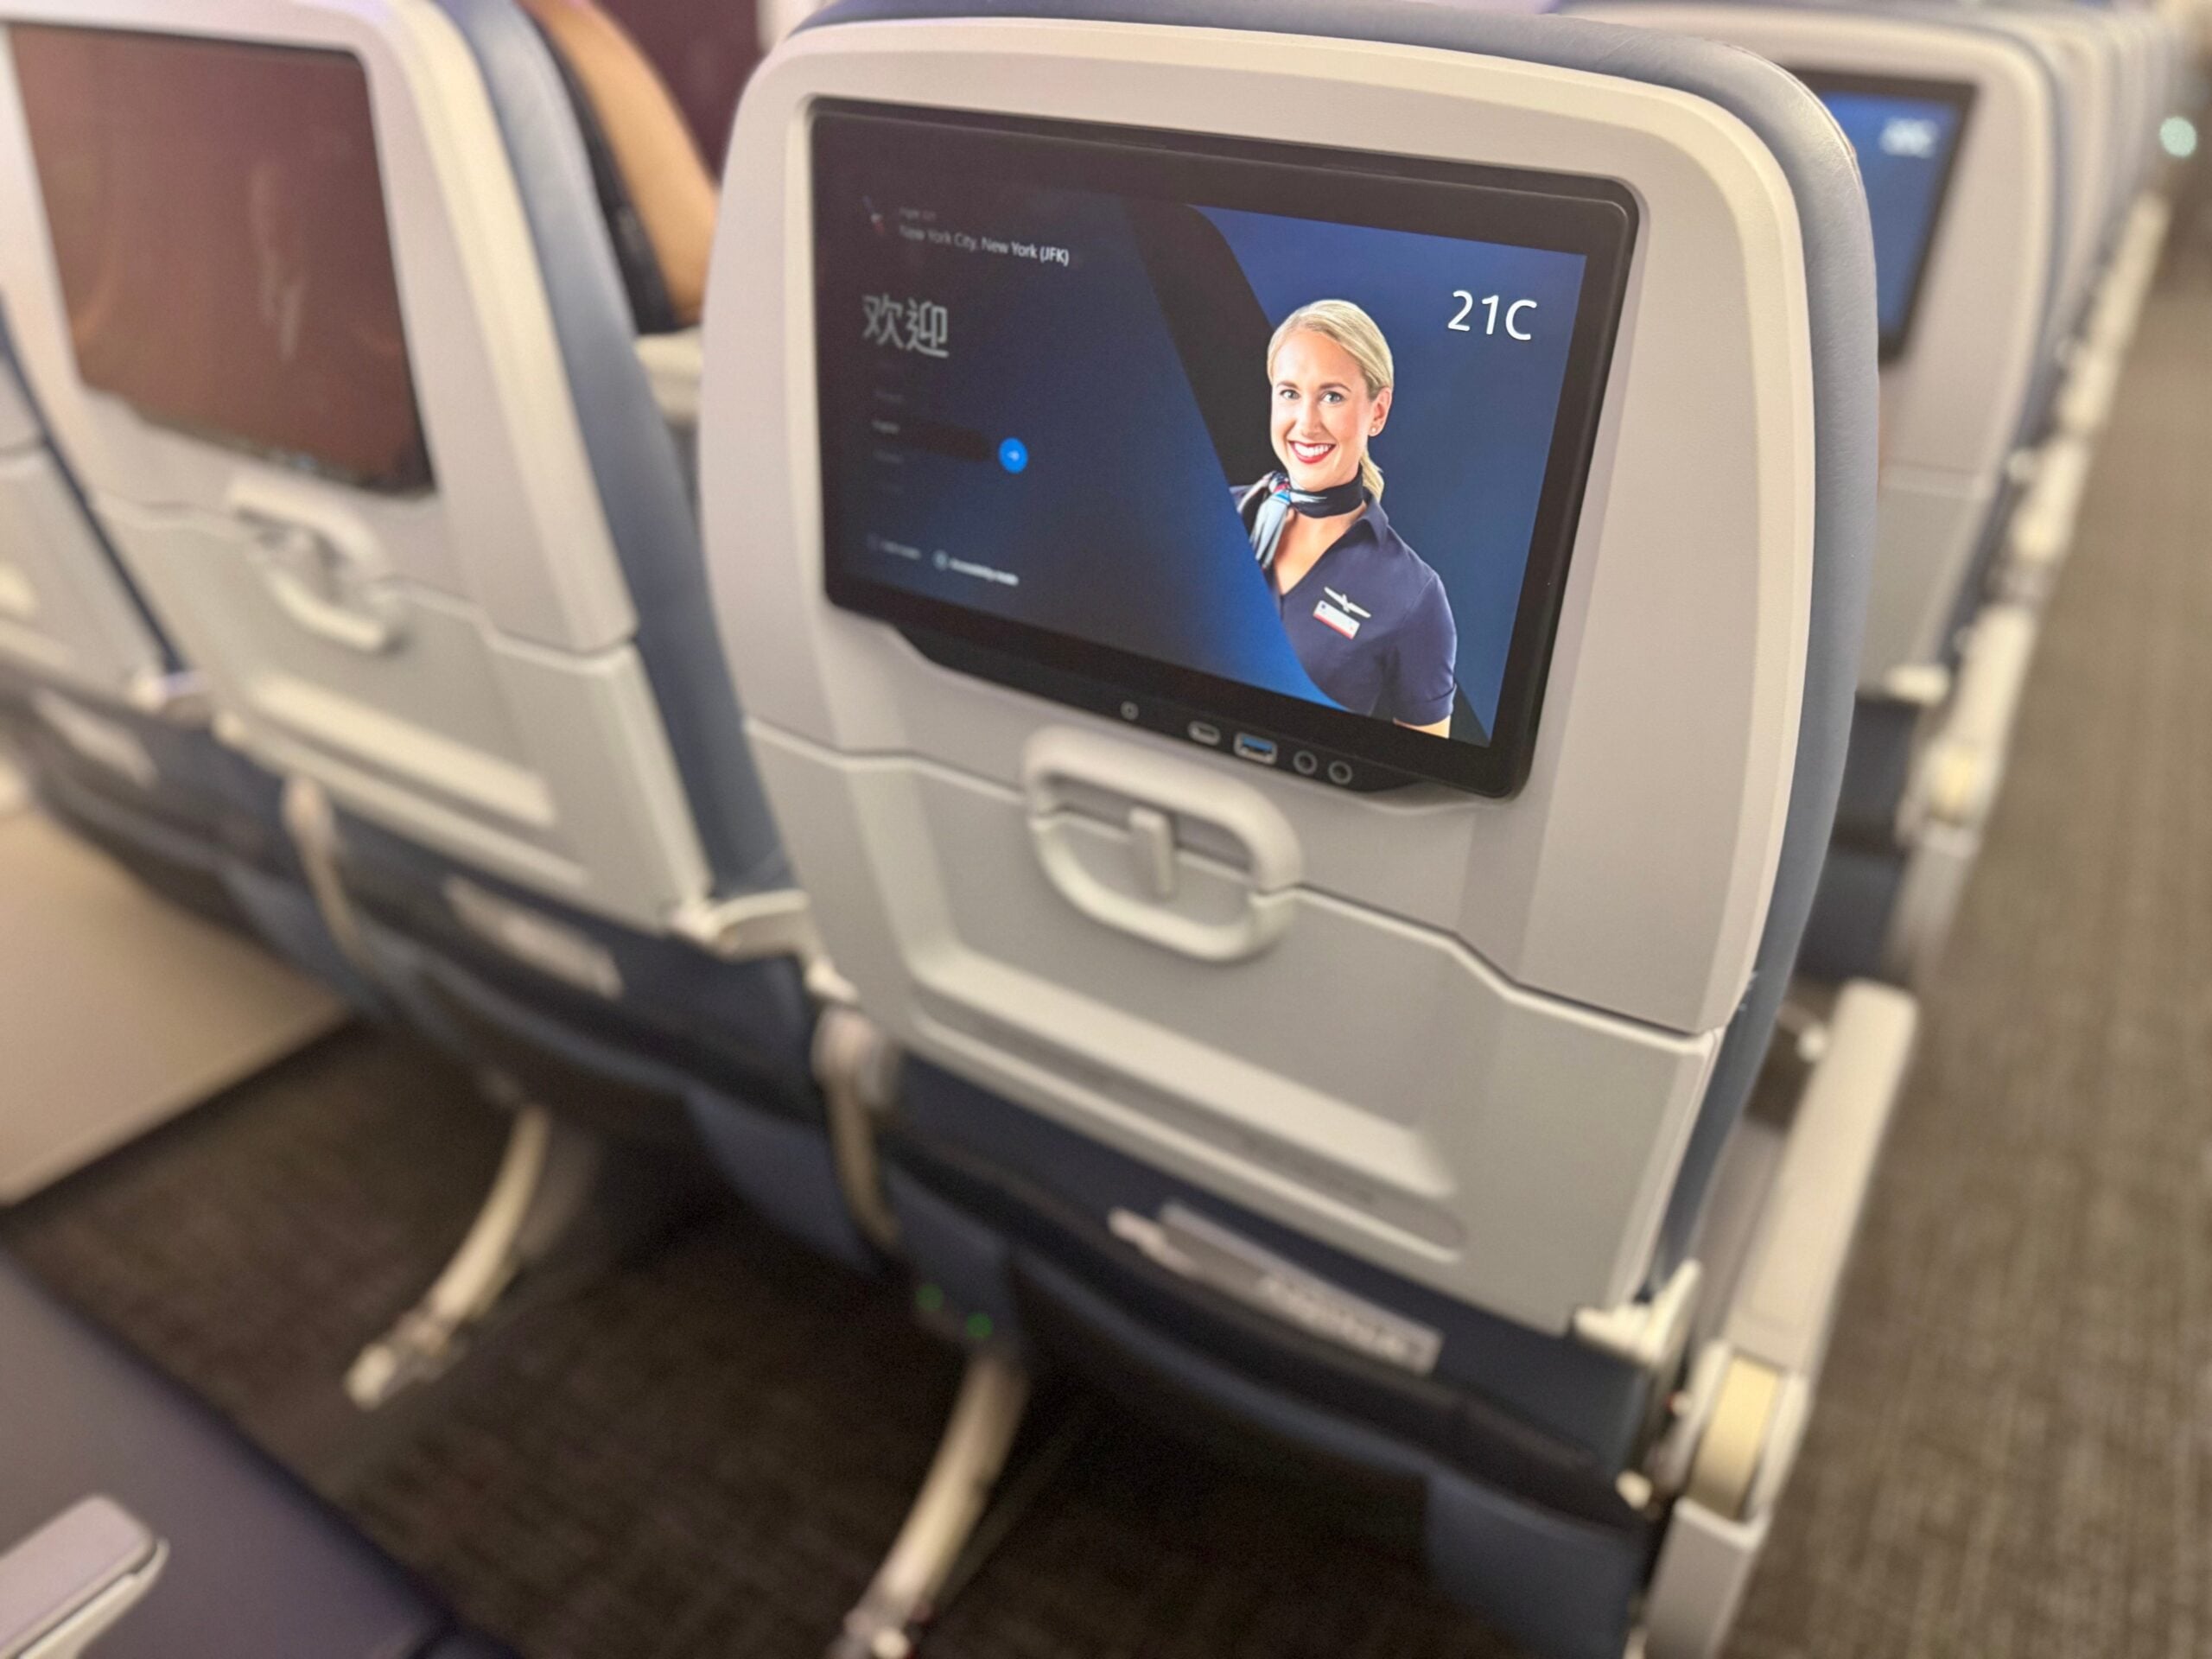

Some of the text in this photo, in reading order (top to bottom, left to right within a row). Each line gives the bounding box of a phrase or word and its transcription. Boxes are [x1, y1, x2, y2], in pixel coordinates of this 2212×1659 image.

[927, 228, 951, 245] York
[982, 236, 1009, 253] New
[1011, 240, 1038, 258] York
[1039, 246, 1069, 266] (JFK)
[862, 294, 949, 358] 欢迎
[1448, 290, 1537, 340] 21C
